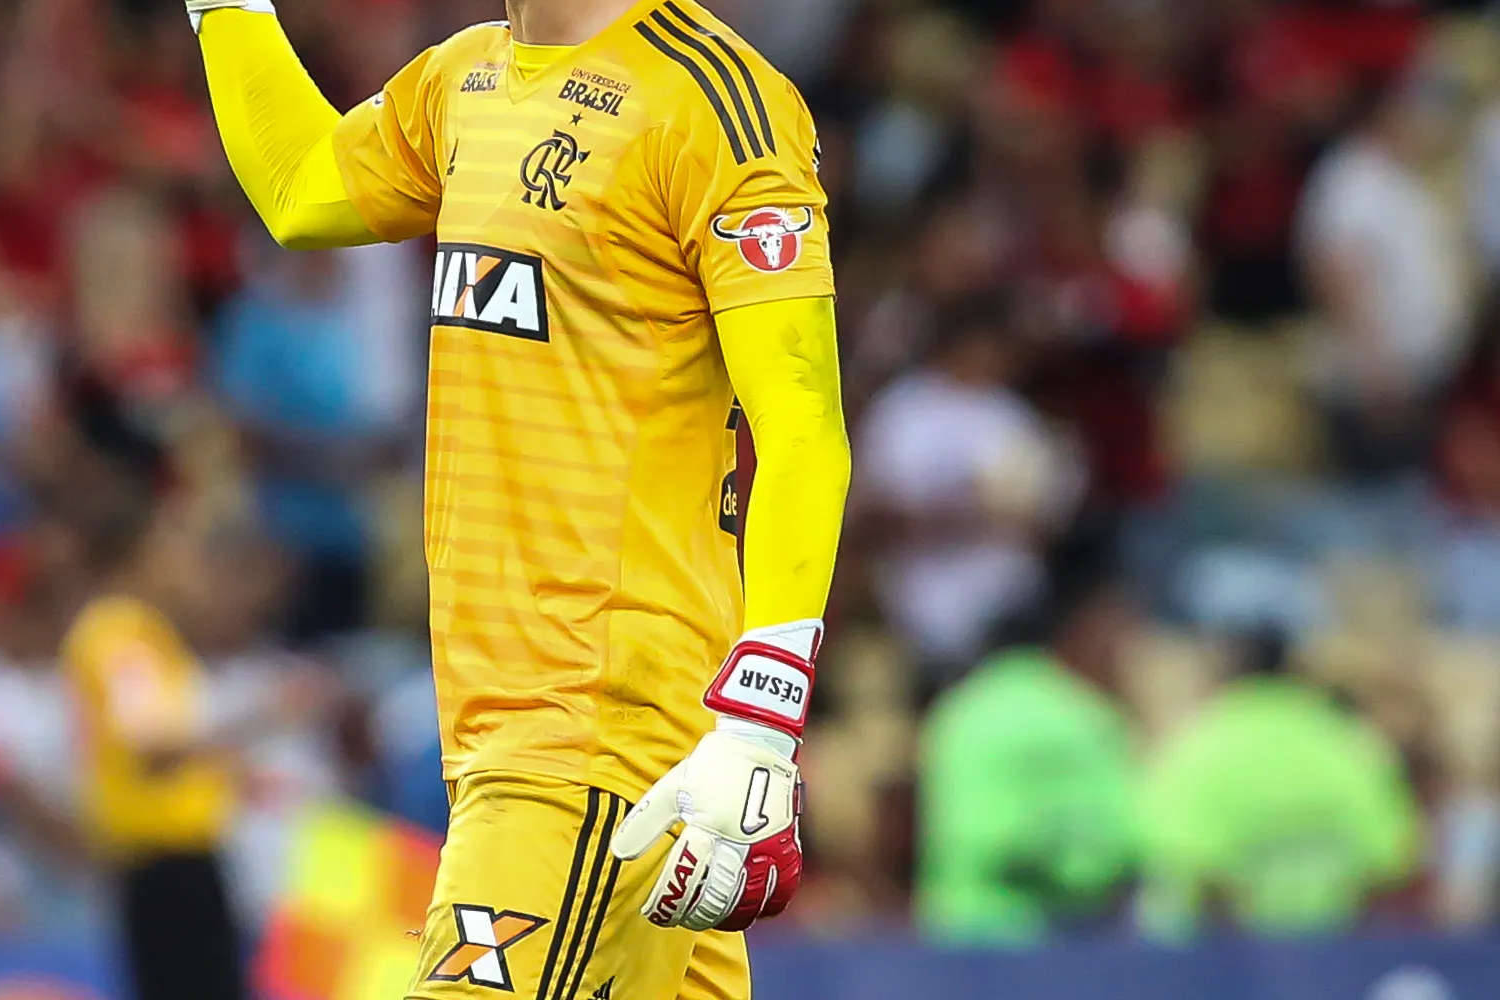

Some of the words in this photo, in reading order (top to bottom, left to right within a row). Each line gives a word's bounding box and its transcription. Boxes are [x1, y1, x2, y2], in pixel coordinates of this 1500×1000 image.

[557, 78, 625, 118] BRASIL
[571, 66, 632, 94] UNIVERSIDADE
[738, 668, 804, 705] CÉSAR
[739, 766, 771, 836] 1
